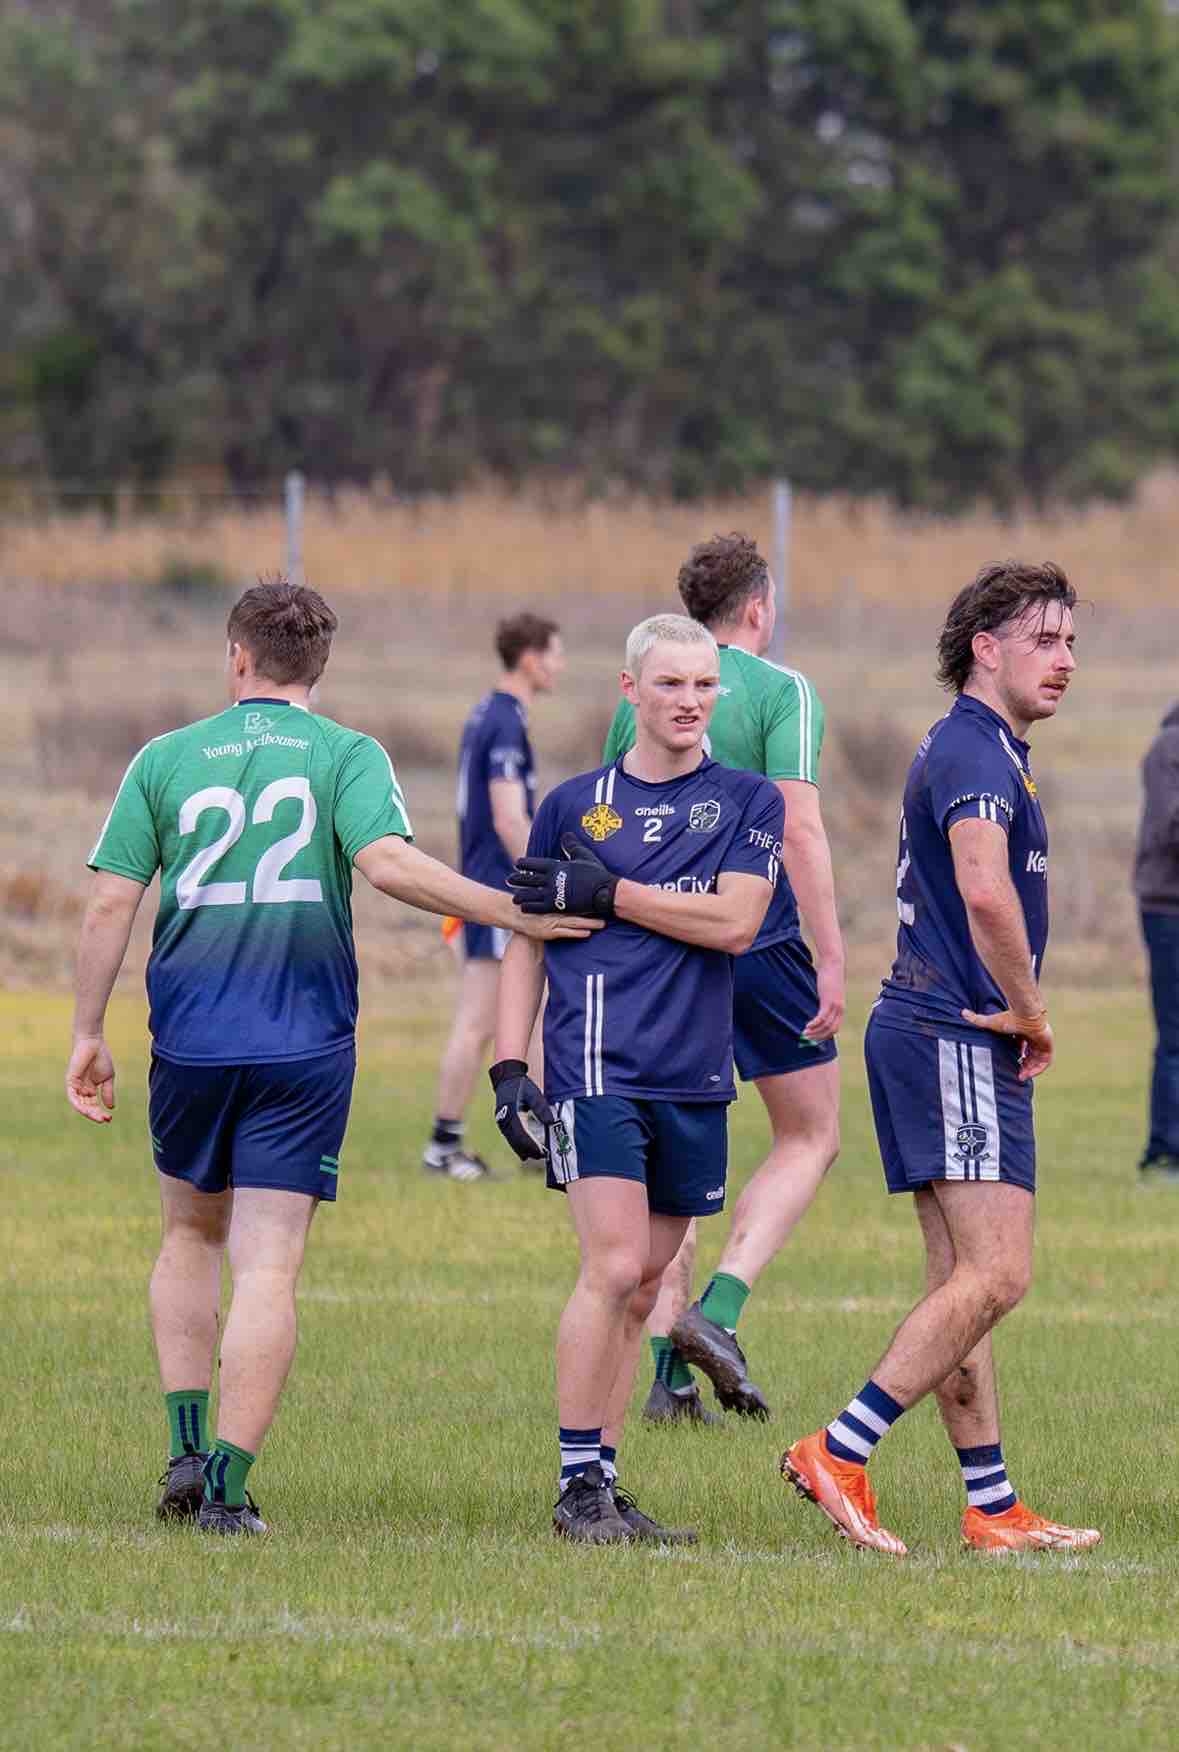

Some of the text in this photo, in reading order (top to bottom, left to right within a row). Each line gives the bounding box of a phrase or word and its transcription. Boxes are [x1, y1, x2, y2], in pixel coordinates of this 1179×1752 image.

[203, 743, 242, 760] Young
[642, 817, 663, 843] 2
[748, 828, 774, 849] THE
[175, 776, 323, 910] 22
